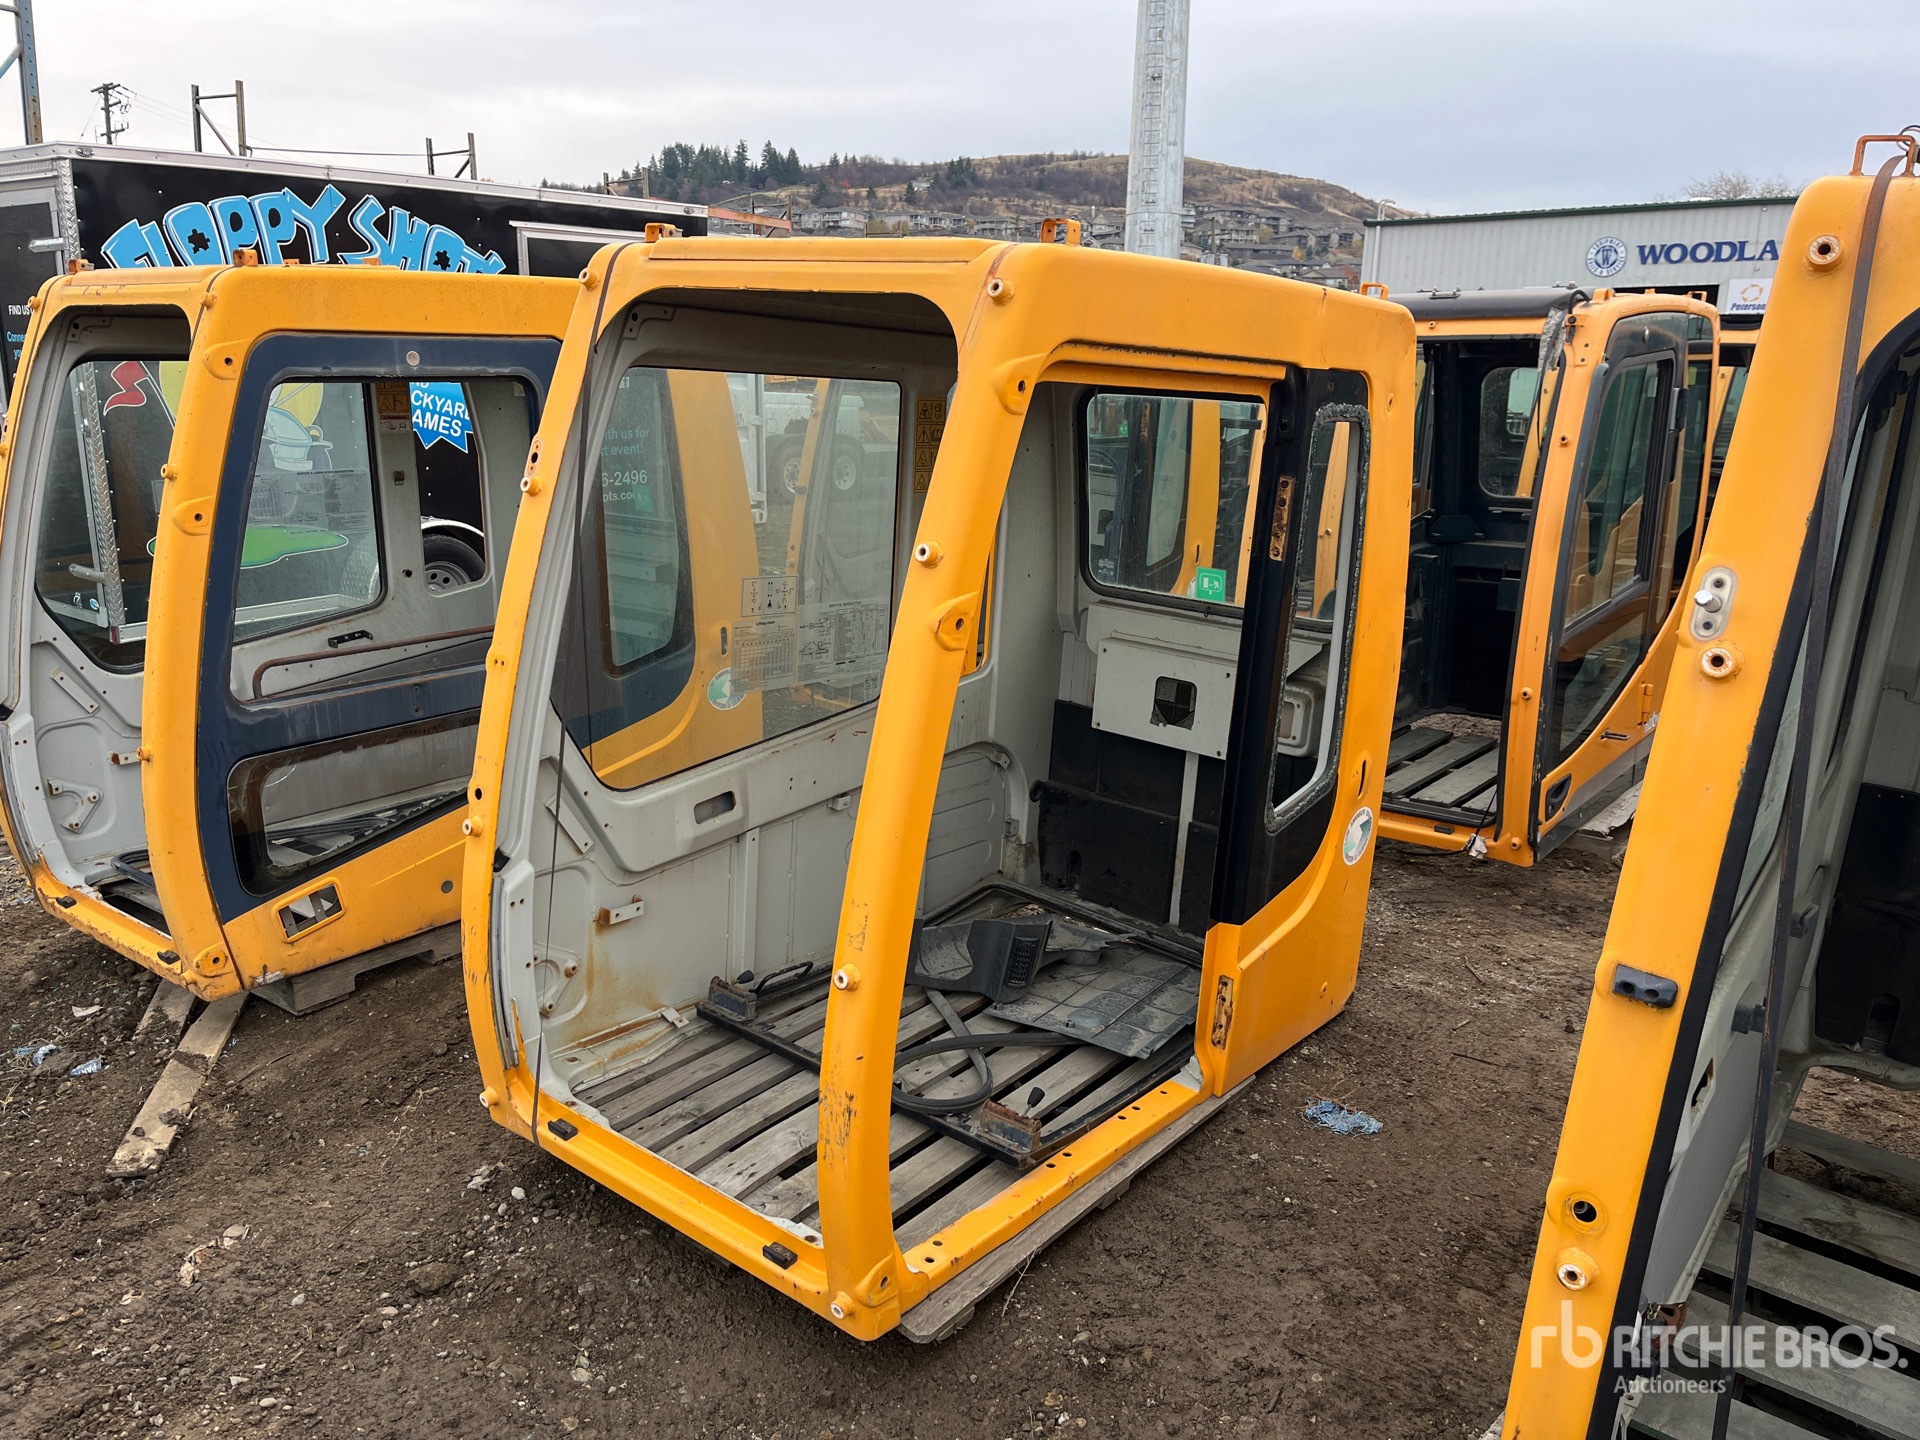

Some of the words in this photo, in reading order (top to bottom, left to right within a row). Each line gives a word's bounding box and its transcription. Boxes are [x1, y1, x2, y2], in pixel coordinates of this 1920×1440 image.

[101, 184, 346, 269] FLOPPY
[1636, 239, 1779, 265] WOODLA
[8, 304, 21, 315] FIND
[22, 304, 30, 315] US
[621, 430, 633, 439] us
[635, 426, 650, 438] for
[611, 442, 644, 456] event!
[602, 469, 648, 487] 6-2496
